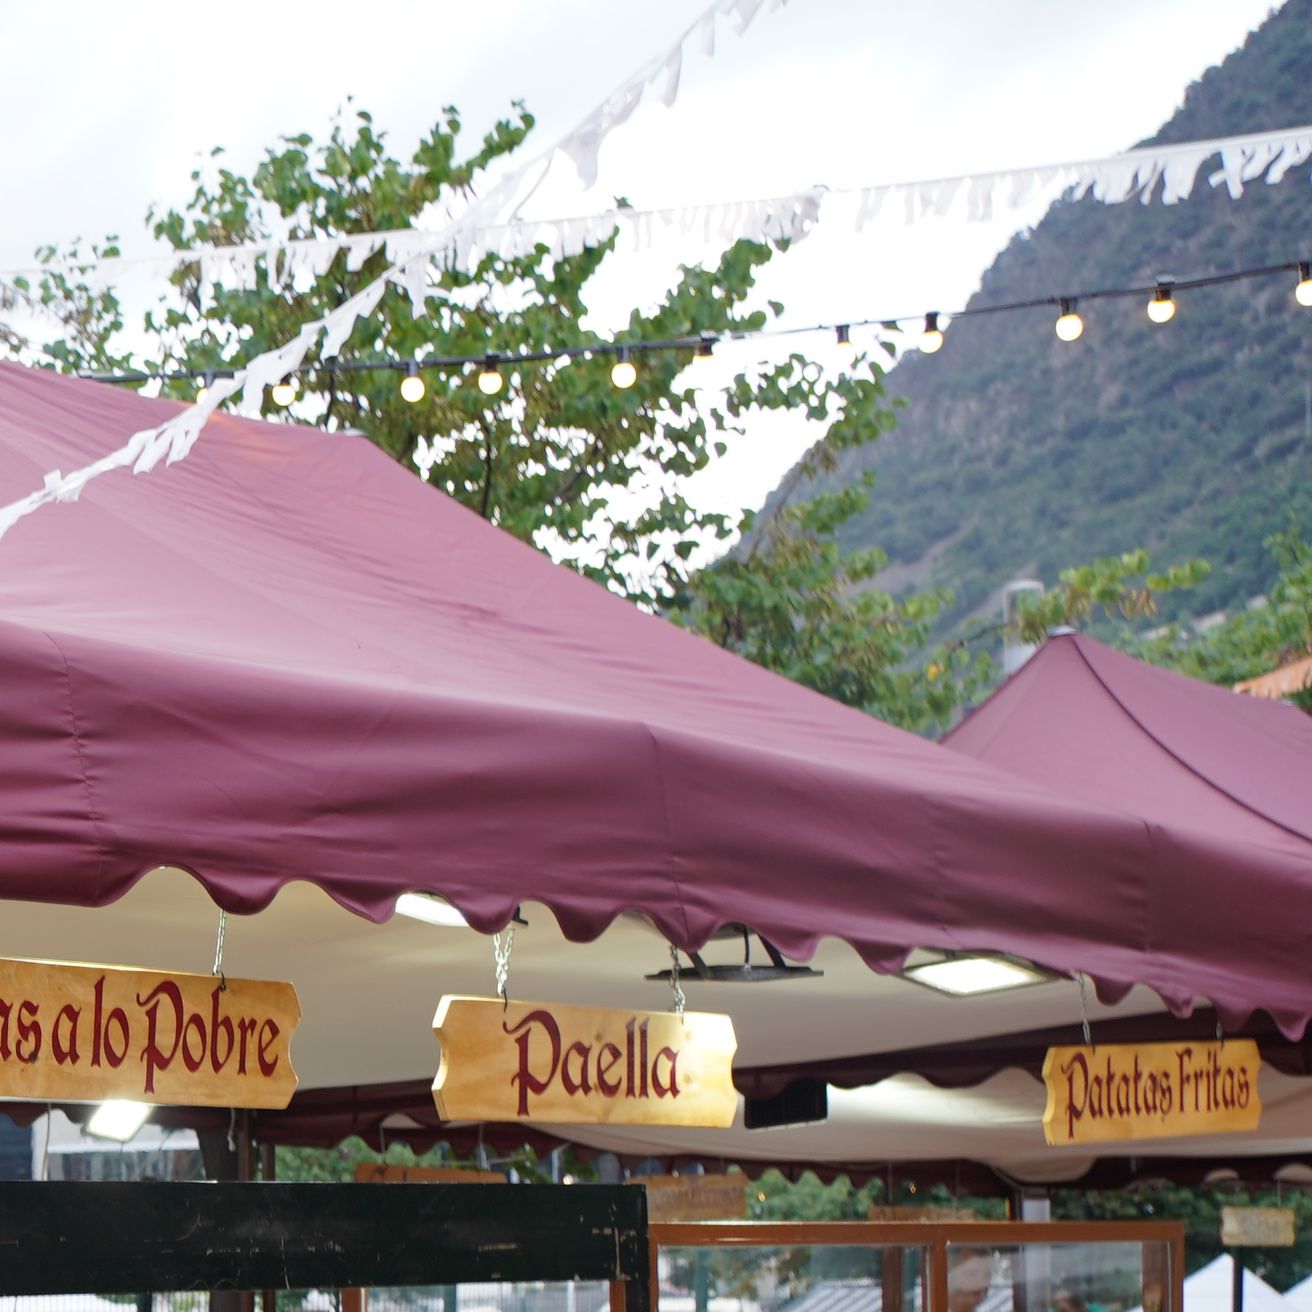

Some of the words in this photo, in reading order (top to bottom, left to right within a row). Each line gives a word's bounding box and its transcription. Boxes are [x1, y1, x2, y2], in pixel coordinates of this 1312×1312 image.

[51, 1004, 82, 1066] a
[91, 975, 131, 1069] lo
[135, 979, 281, 1095] Pobre
[502, 1010, 682, 1118] Paella
[1062, 1050, 1173, 1140] Patatas
[1175, 1046, 1252, 1114] Fritas
